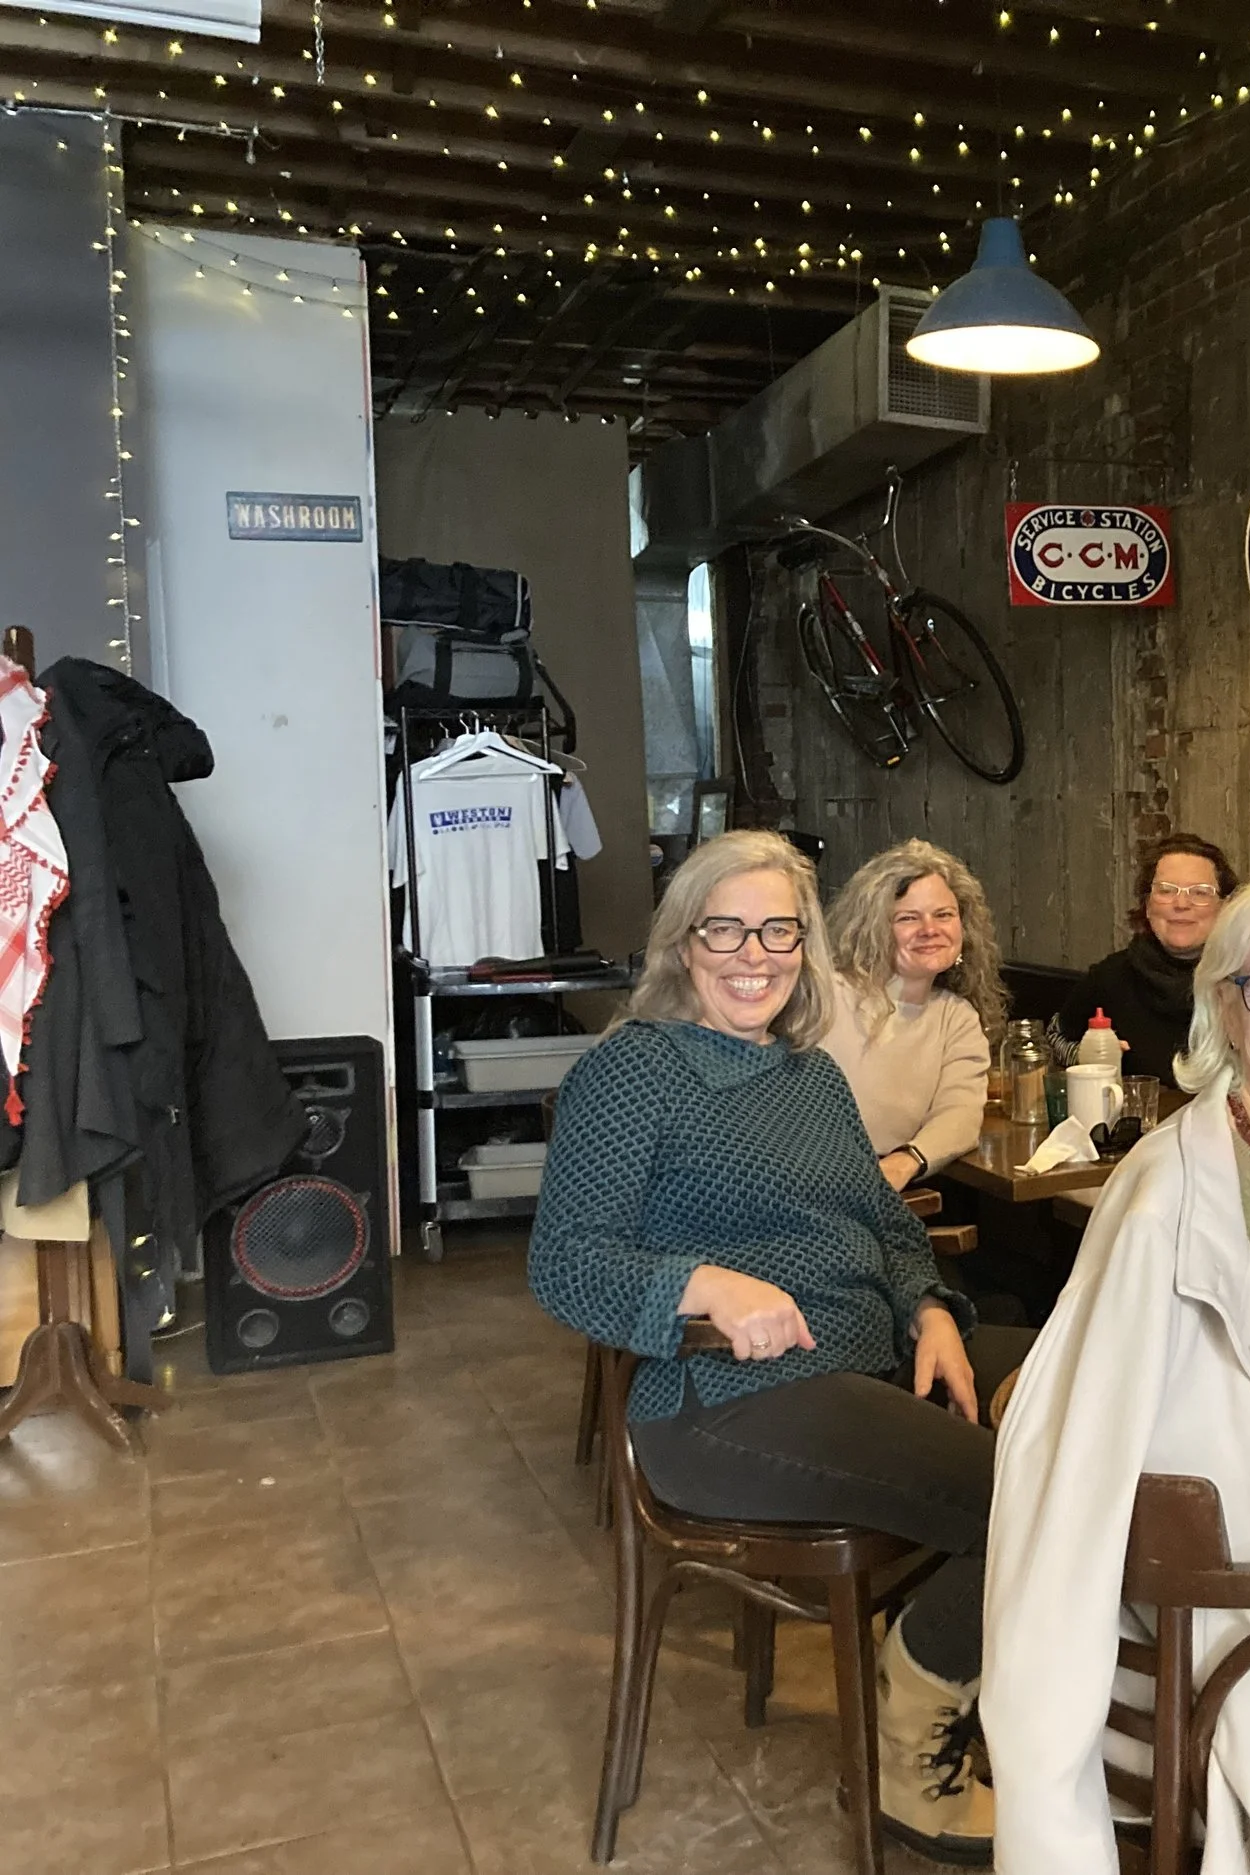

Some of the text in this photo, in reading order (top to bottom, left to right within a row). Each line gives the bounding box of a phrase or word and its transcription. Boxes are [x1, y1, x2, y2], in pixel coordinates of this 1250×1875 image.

[234, 503, 356, 530] WASHROOM
[1017, 510, 1163, 553] SERVICE STATION
[1032, 573, 1156, 600] BICYCLES
[446, 807, 508, 820] WESTON
